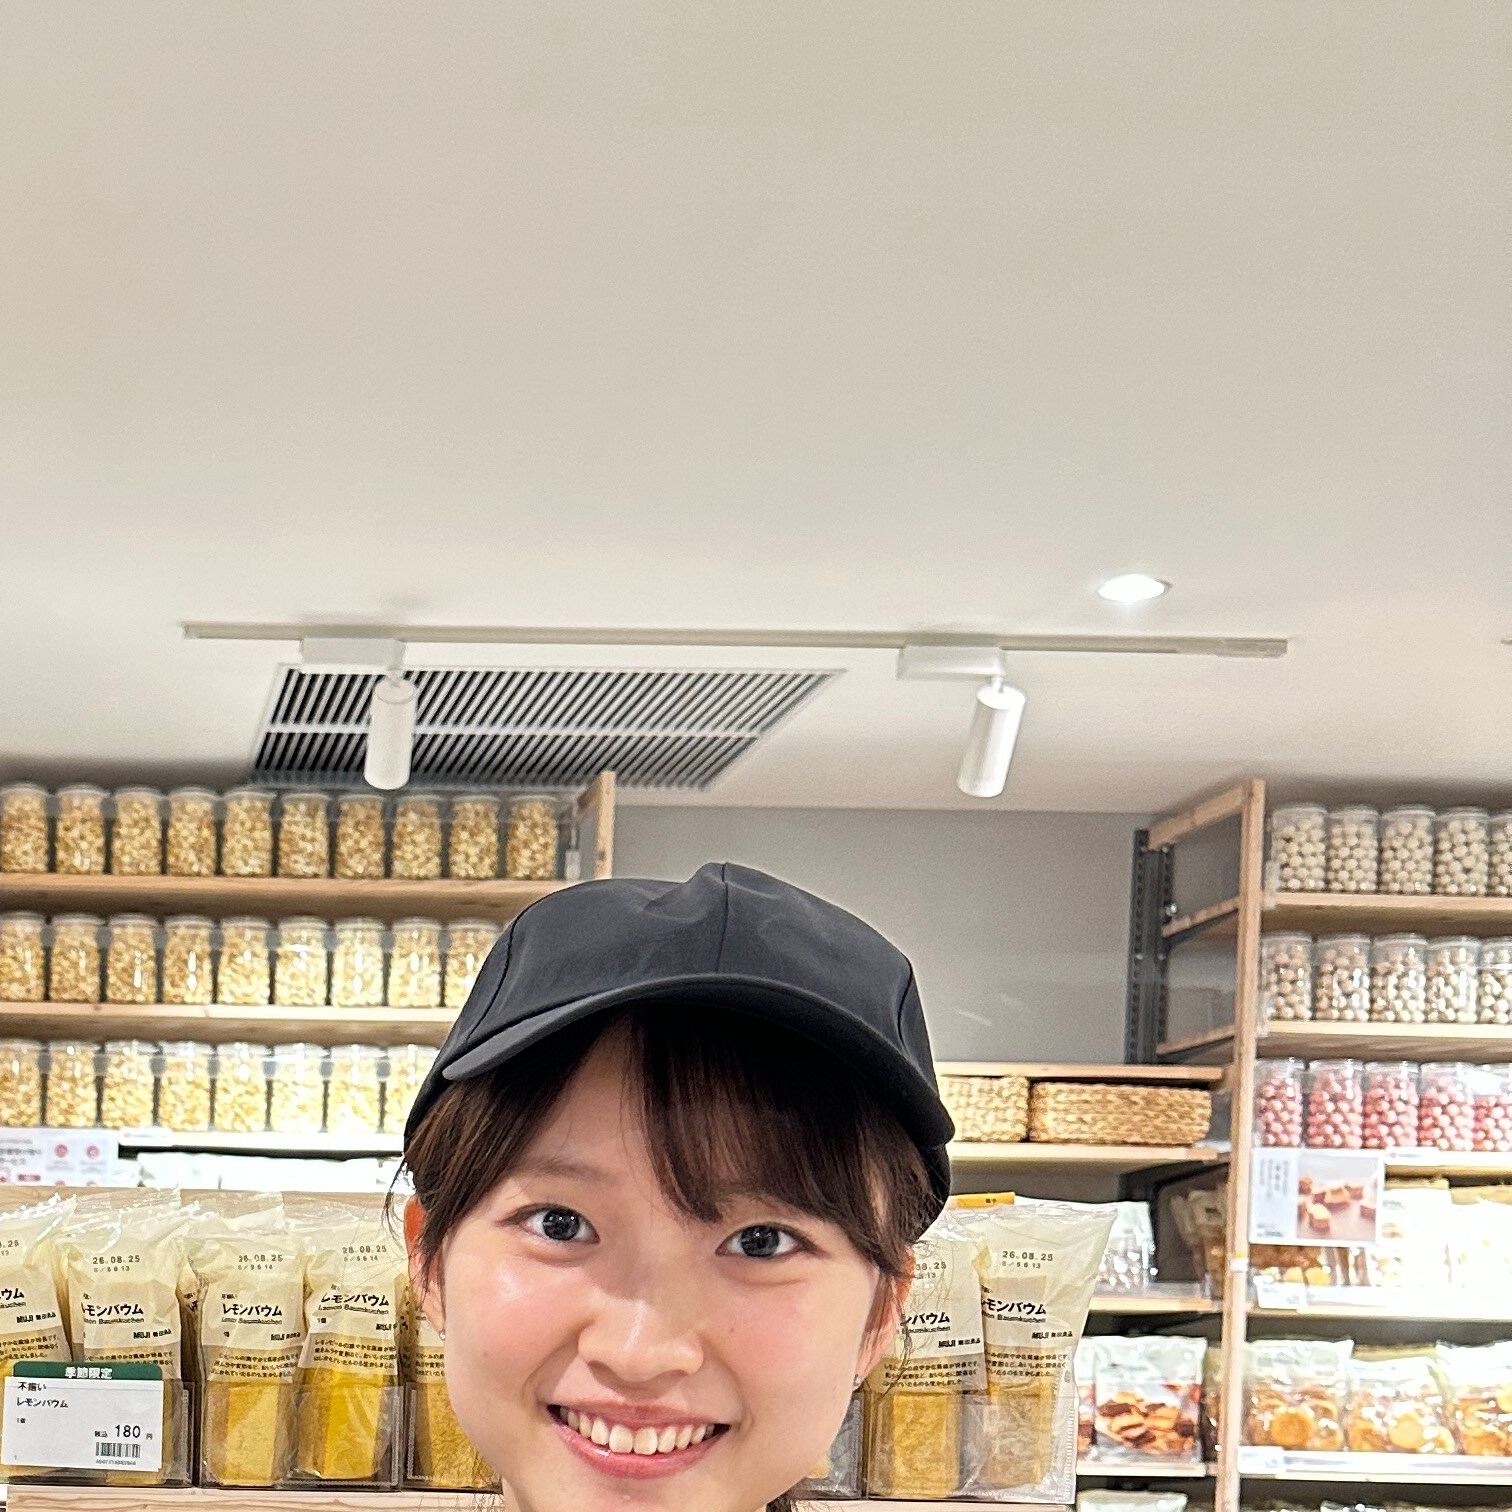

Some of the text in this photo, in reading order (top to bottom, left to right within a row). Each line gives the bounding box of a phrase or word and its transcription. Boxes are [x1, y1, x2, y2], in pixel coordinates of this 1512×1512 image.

[342, 1245, 387, 1254] 26.08.25
[92, 1255, 140, 1264] 26.08.25
[238, 1254, 283, 1262] 26.08.25
[1002, 1251, 1053, 1261] 26.08.25
[321, 1293, 389, 1306] レモンバウム
[222, 1303, 282, 1316] レモンバウム
[133, 1331, 150, 1339] MUJI
[1032, 1331, 1048, 1339] MUJI
[938, 1340, 956, 1348] MUJI
[65, 1367, 113, 1379] 季節限定
[17, 1382, 46, 1391] 不揃い
[16, 1397, 68, 1408] レモンバウム
[115, 1424, 141, 1438] 180
